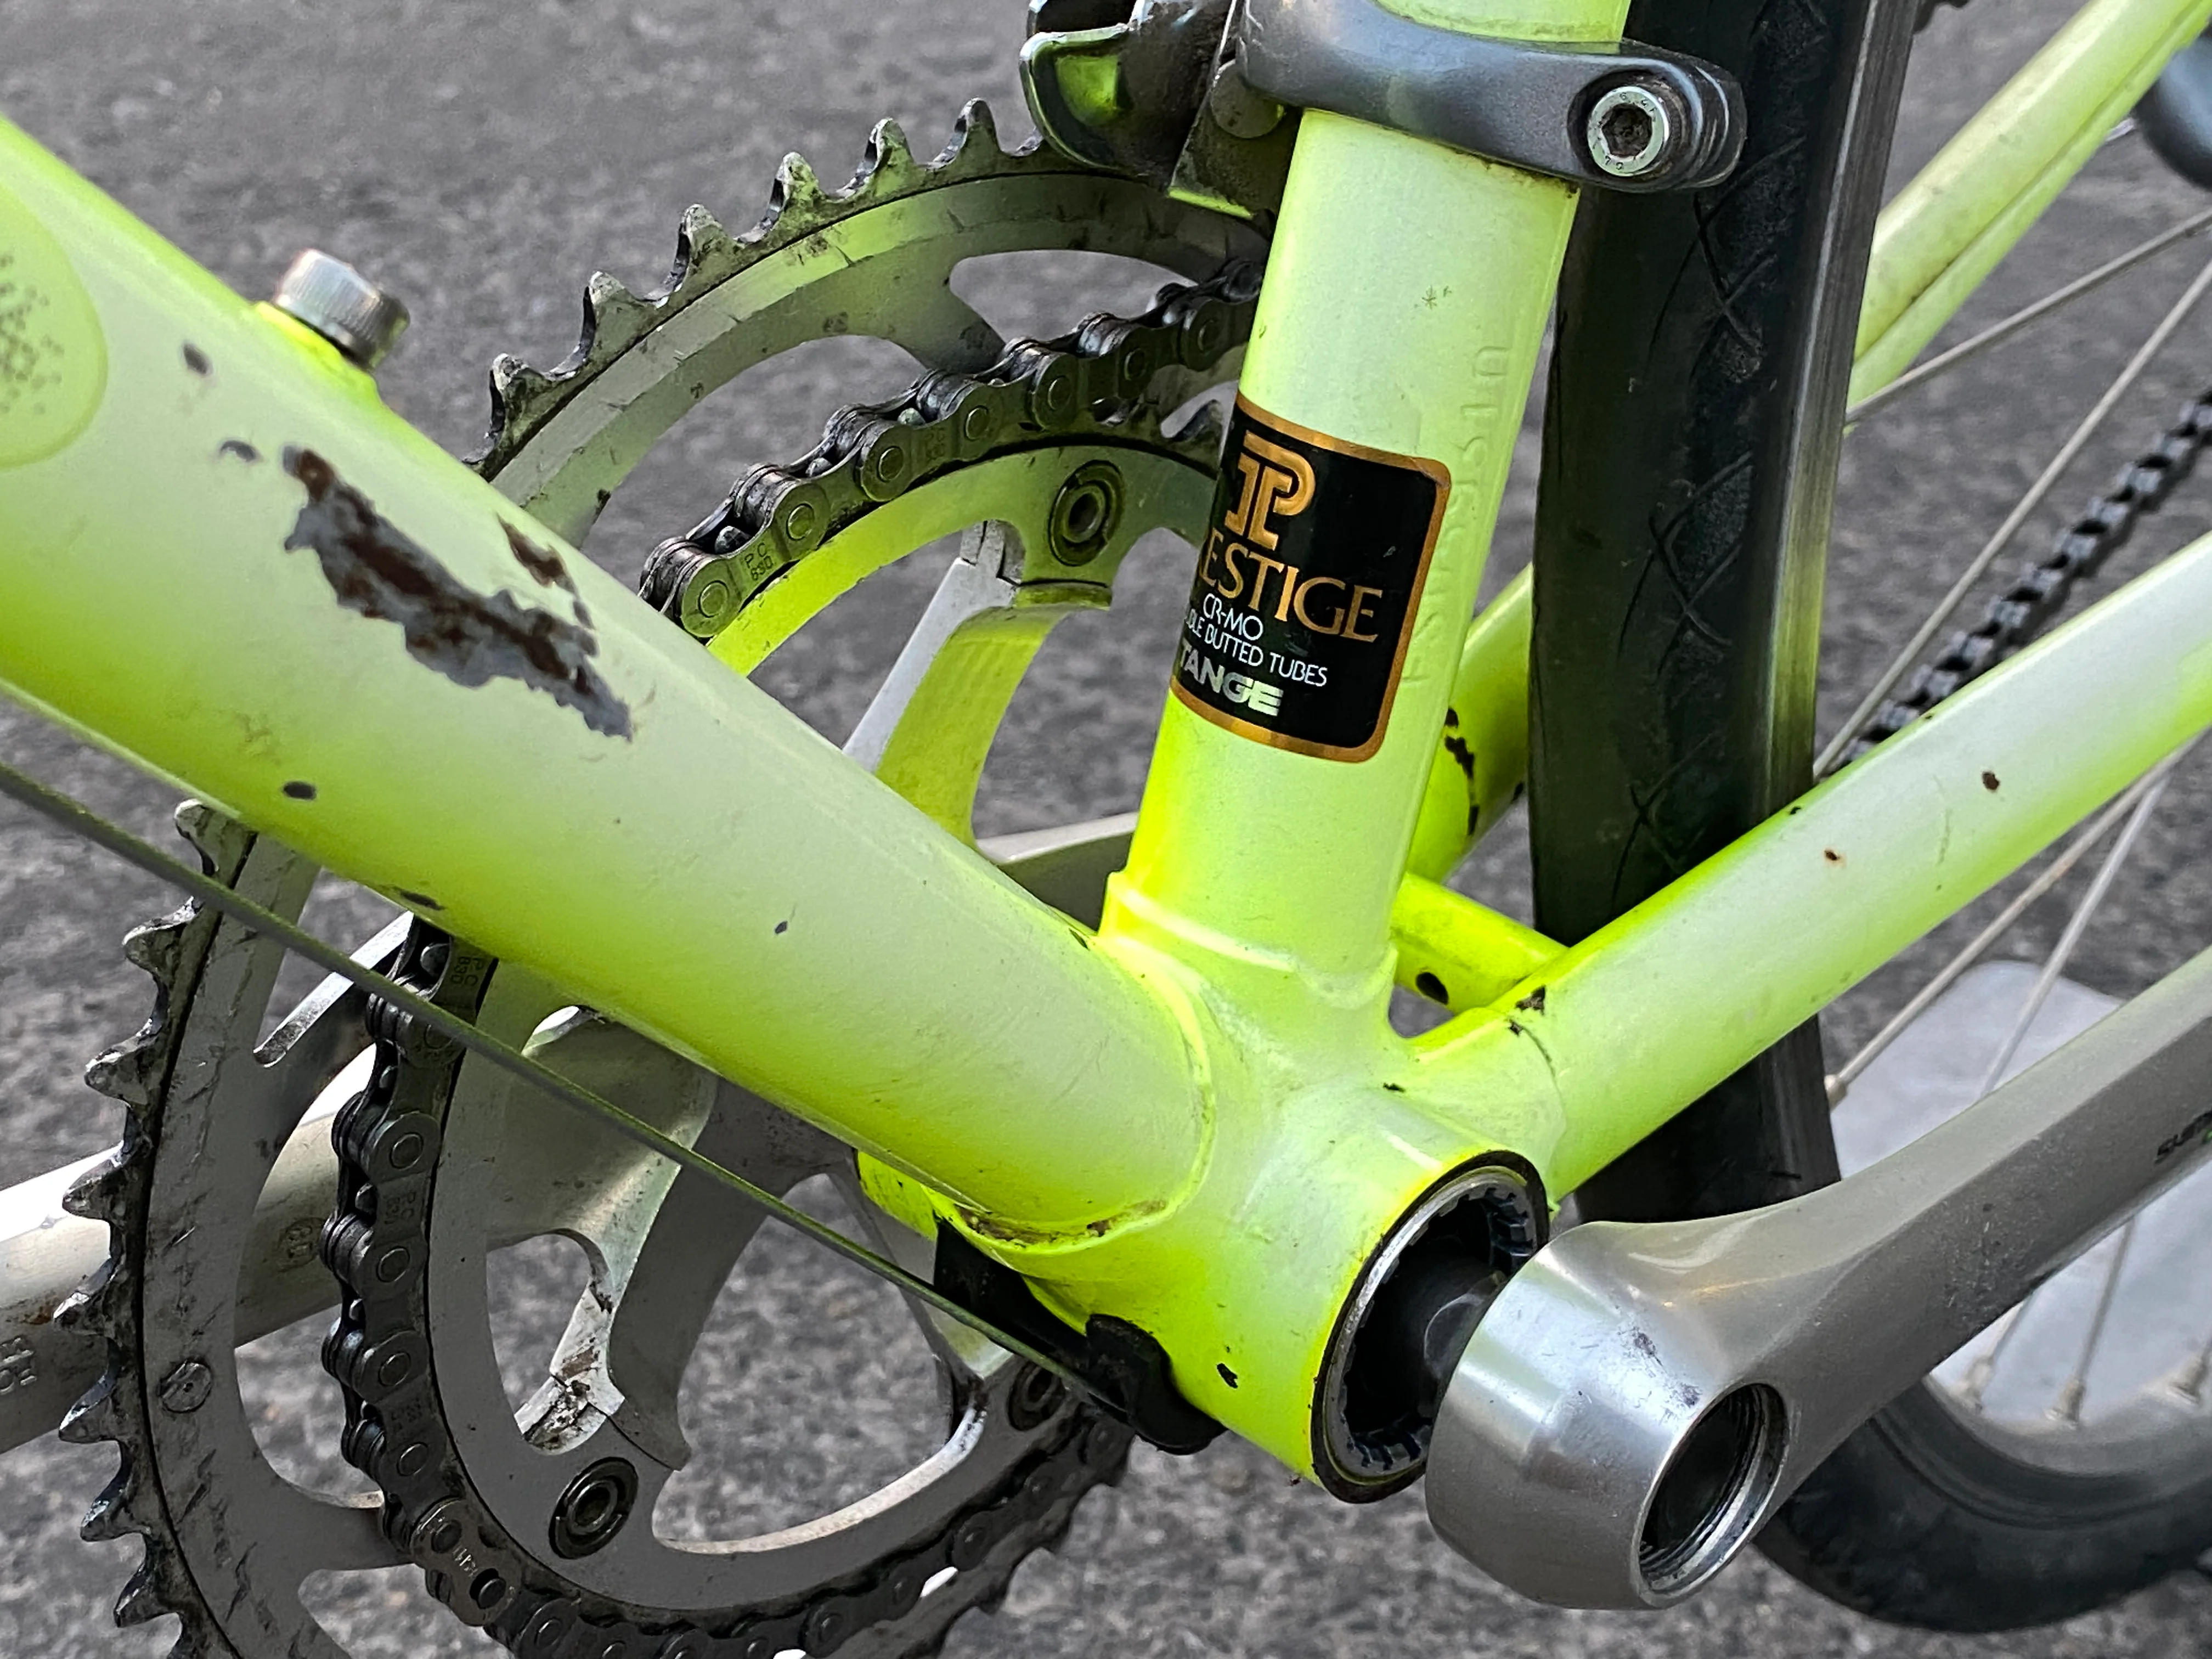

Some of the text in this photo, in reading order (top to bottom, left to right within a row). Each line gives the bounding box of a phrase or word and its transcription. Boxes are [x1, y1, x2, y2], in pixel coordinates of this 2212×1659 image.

[1200, 527, 1383, 642] ESTIGE
[1203, 593, 1263, 641] CR-MO
[1180, 637, 1284, 716] TANGE
[1204, 623, 1263, 667] BUTTED
[1269, 652, 1328, 687] TUBES
